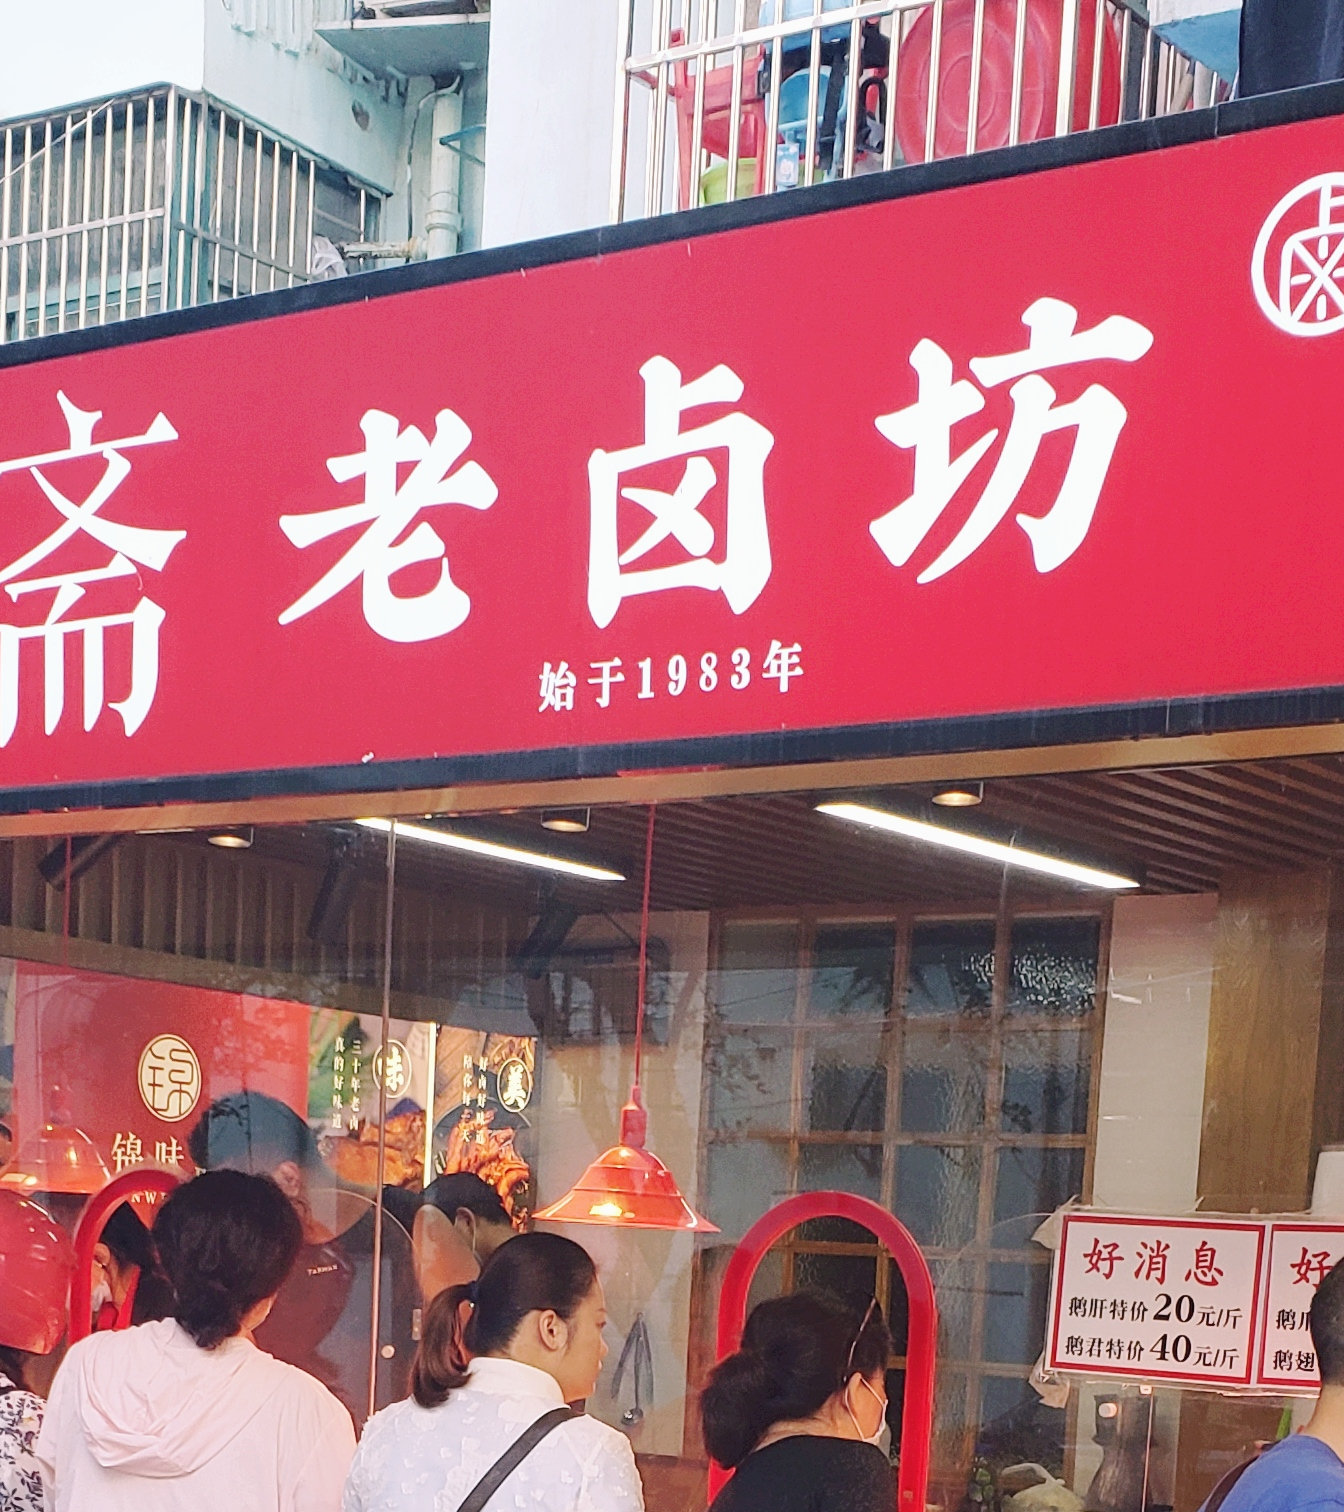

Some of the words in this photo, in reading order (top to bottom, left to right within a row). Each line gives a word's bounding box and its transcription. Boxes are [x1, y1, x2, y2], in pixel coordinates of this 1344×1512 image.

[537, 639, 805, 713] 始于1983年
[502, 1063, 527, 1110] 美
[111, 1131, 206, 1176] 锦味
[1082, 1237, 1224, 1287] 好消息
